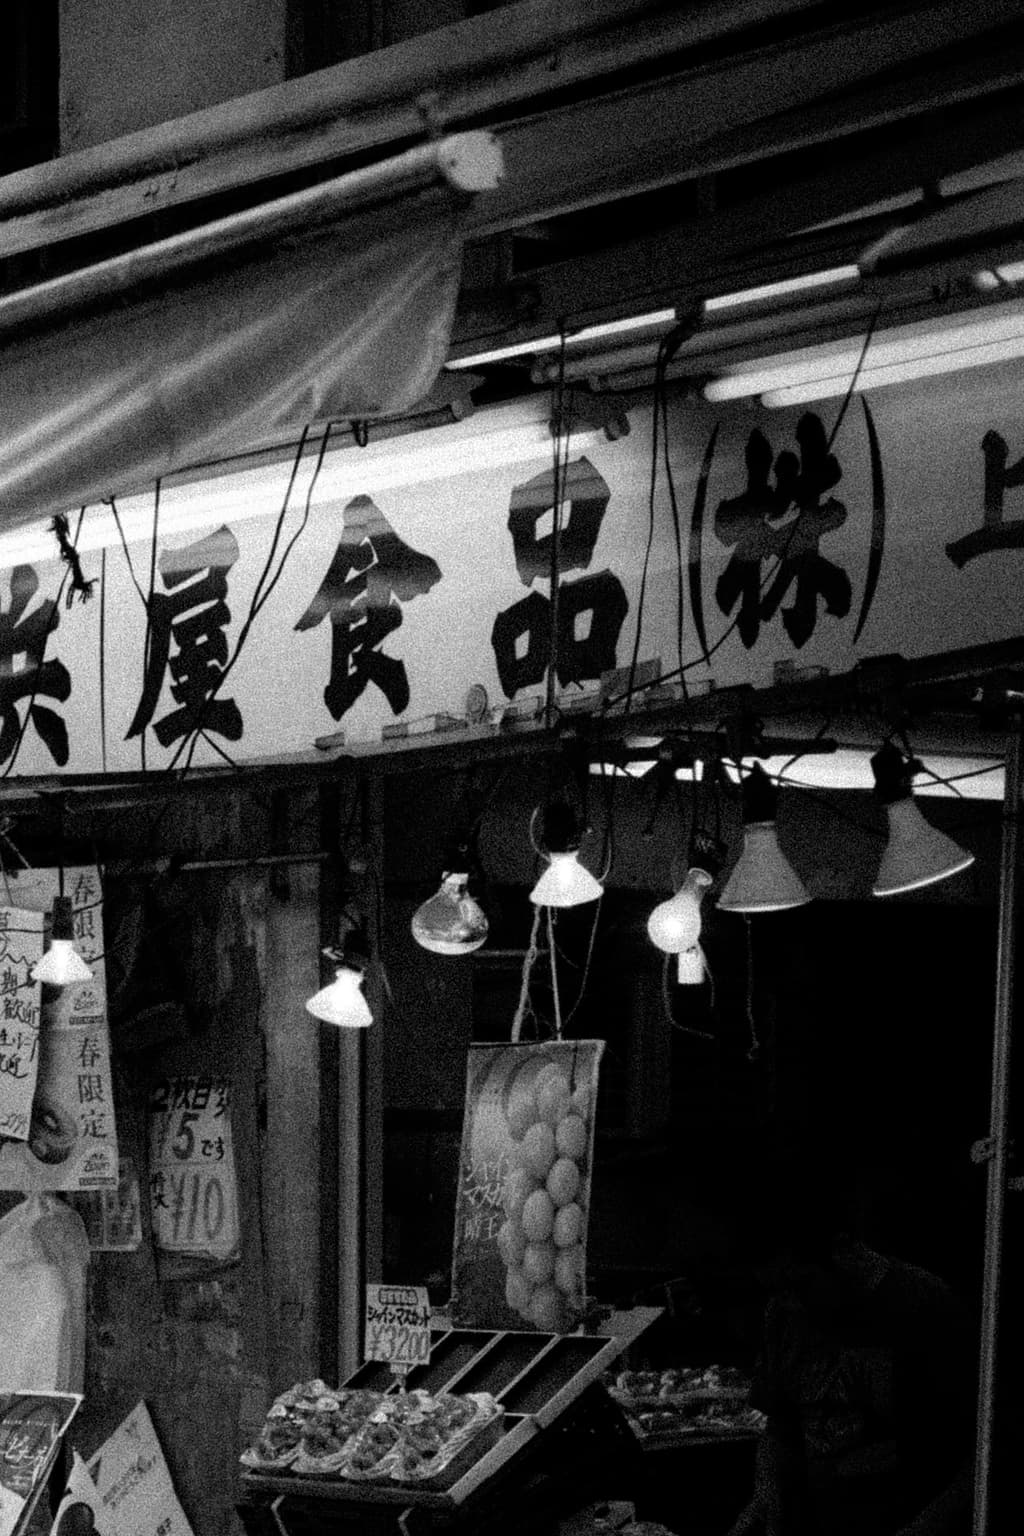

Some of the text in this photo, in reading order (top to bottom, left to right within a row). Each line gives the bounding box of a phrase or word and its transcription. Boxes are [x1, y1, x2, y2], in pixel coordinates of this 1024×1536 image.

[76, 1036, 108, 1139] 春限定
[369, 1324, 429, 1361] ¥3200
